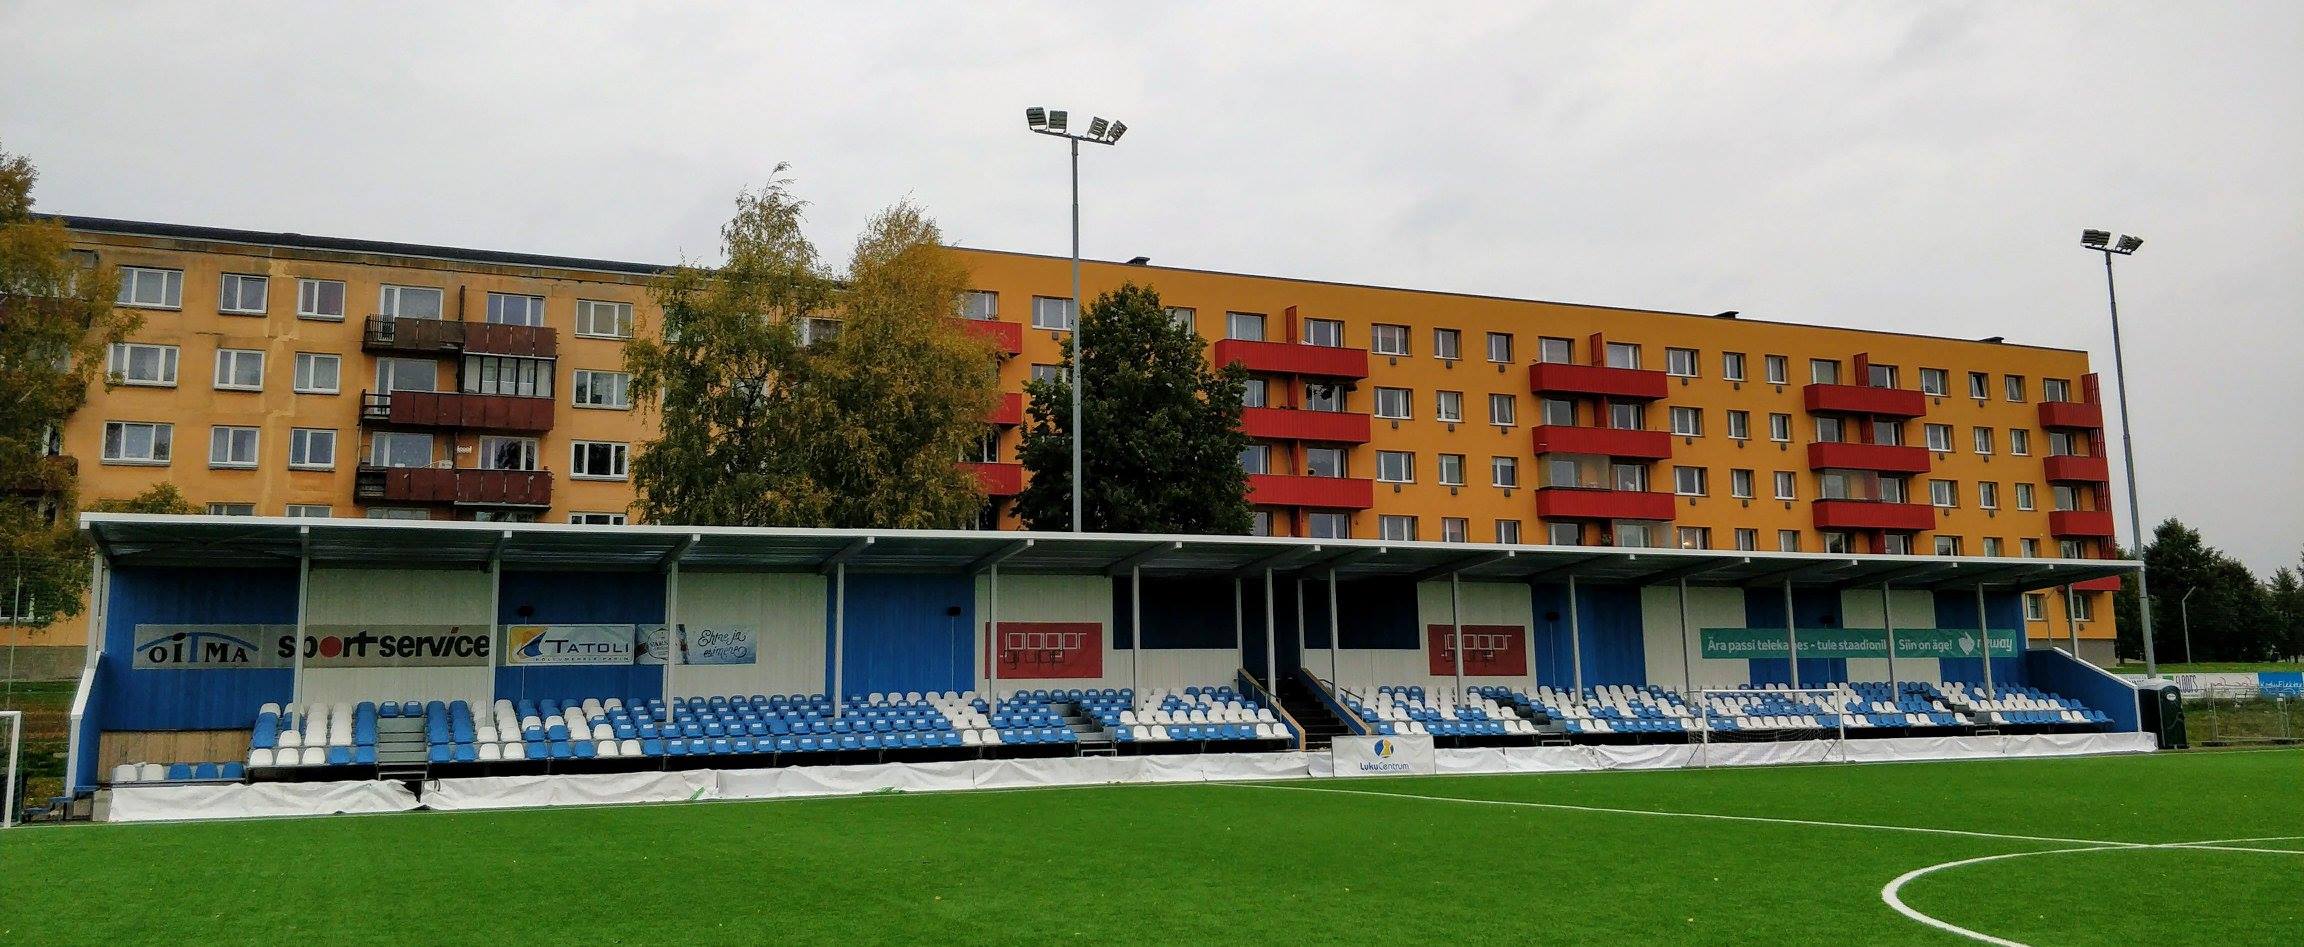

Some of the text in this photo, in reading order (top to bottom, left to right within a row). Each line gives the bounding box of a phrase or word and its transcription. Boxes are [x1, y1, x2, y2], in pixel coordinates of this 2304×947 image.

[545, 639, 629, 653] TATOLI
[1707, 636, 1727, 650] Ära
[1728, 639, 1756, 653] passi
[1817, 639, 1838, 651] tule
[1899, 638, 1917, 651] Siin
[1918, 641, 1931, 651] on
[1932, 640, 1952, 653] äge!
[1360, 762, 1409, 771] LukuCentrum
